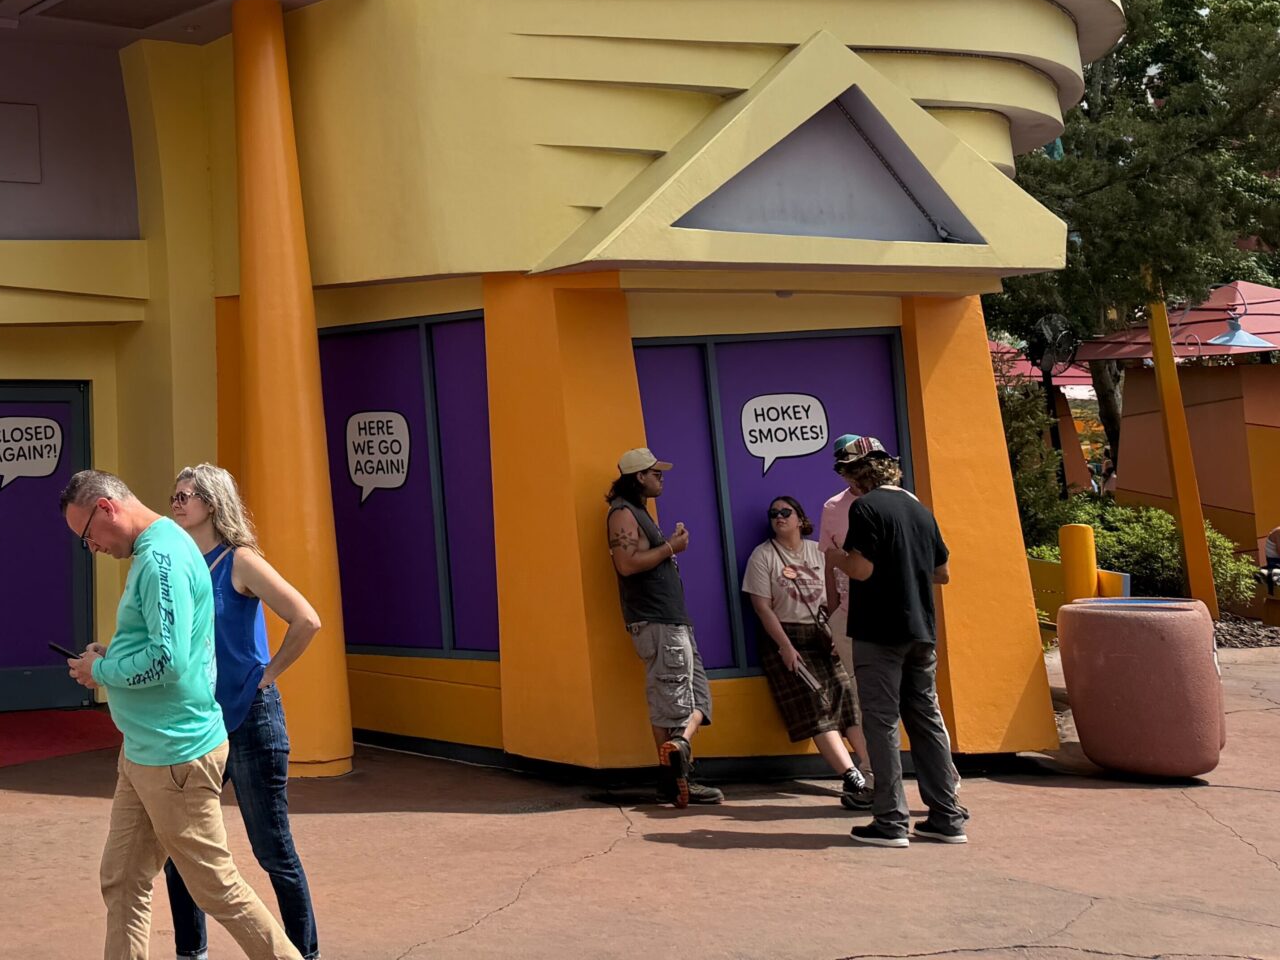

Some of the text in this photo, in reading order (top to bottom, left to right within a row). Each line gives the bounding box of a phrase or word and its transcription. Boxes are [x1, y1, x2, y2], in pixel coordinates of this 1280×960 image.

[753, 403, 811, 423] HOKEY
[357, 419, 395, 436] HERE
[748, 425, 824, 444] SMOKES!
[352, 439, 402, 456] WE GO
[354, 458, 405, 475] AGAIN!
[126, 550, 175, 687] Bimini Bay Outfitters
